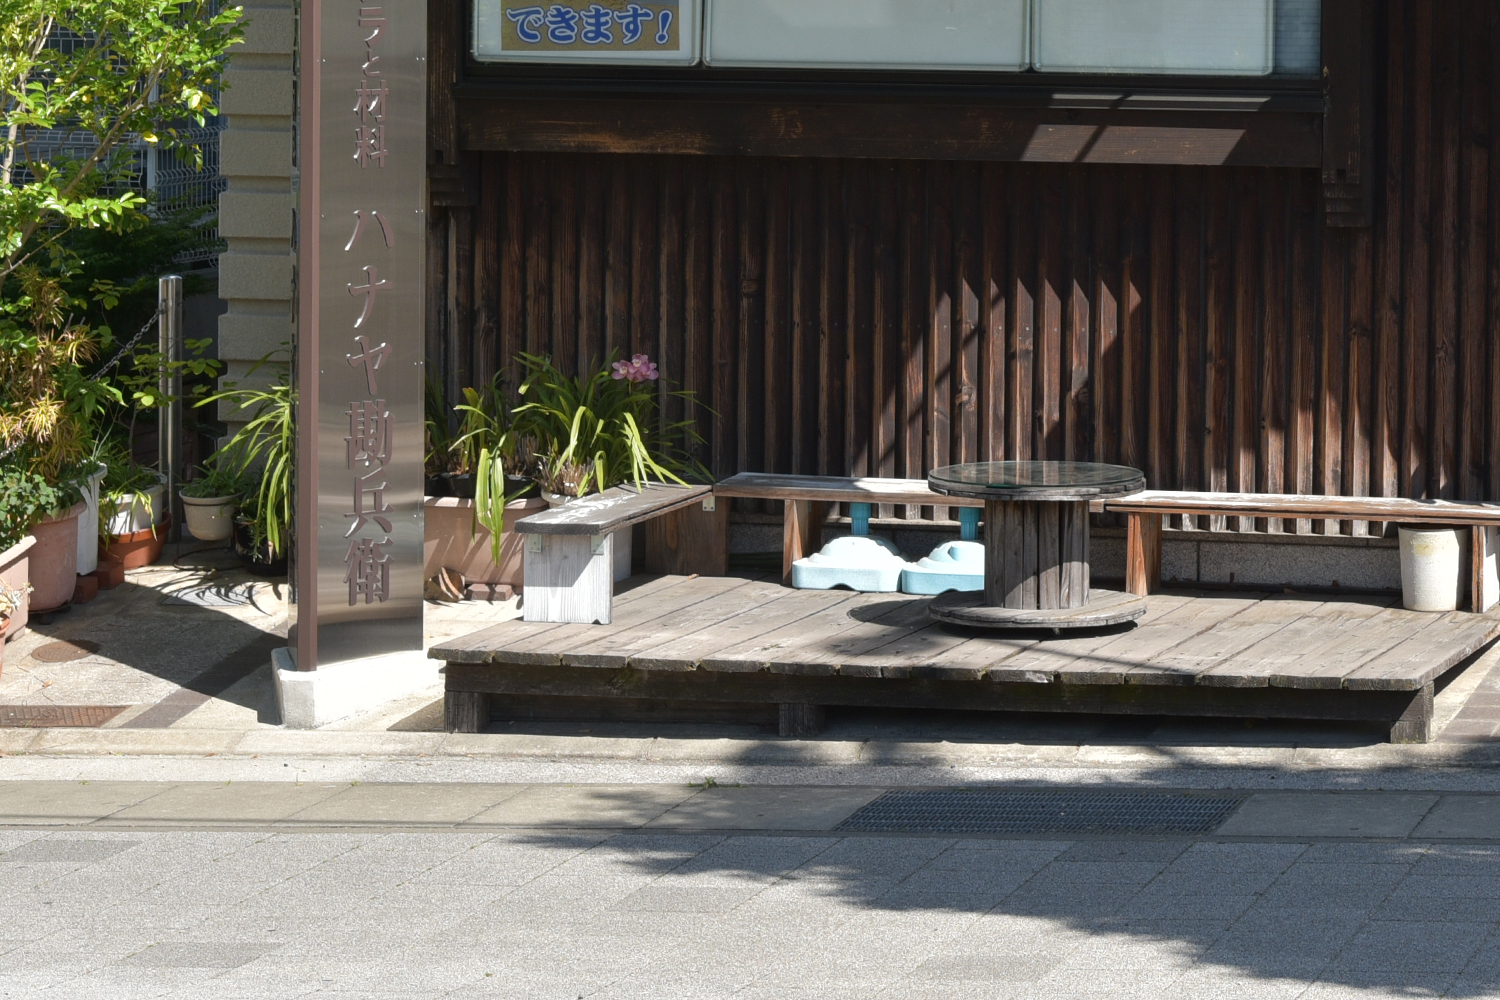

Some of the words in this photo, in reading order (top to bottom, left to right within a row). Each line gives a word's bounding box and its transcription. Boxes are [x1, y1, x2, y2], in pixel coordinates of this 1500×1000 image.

[505, 3, 674, 45] できます!
[344, 207, 395, 607] ハナヤ勘兵衛
